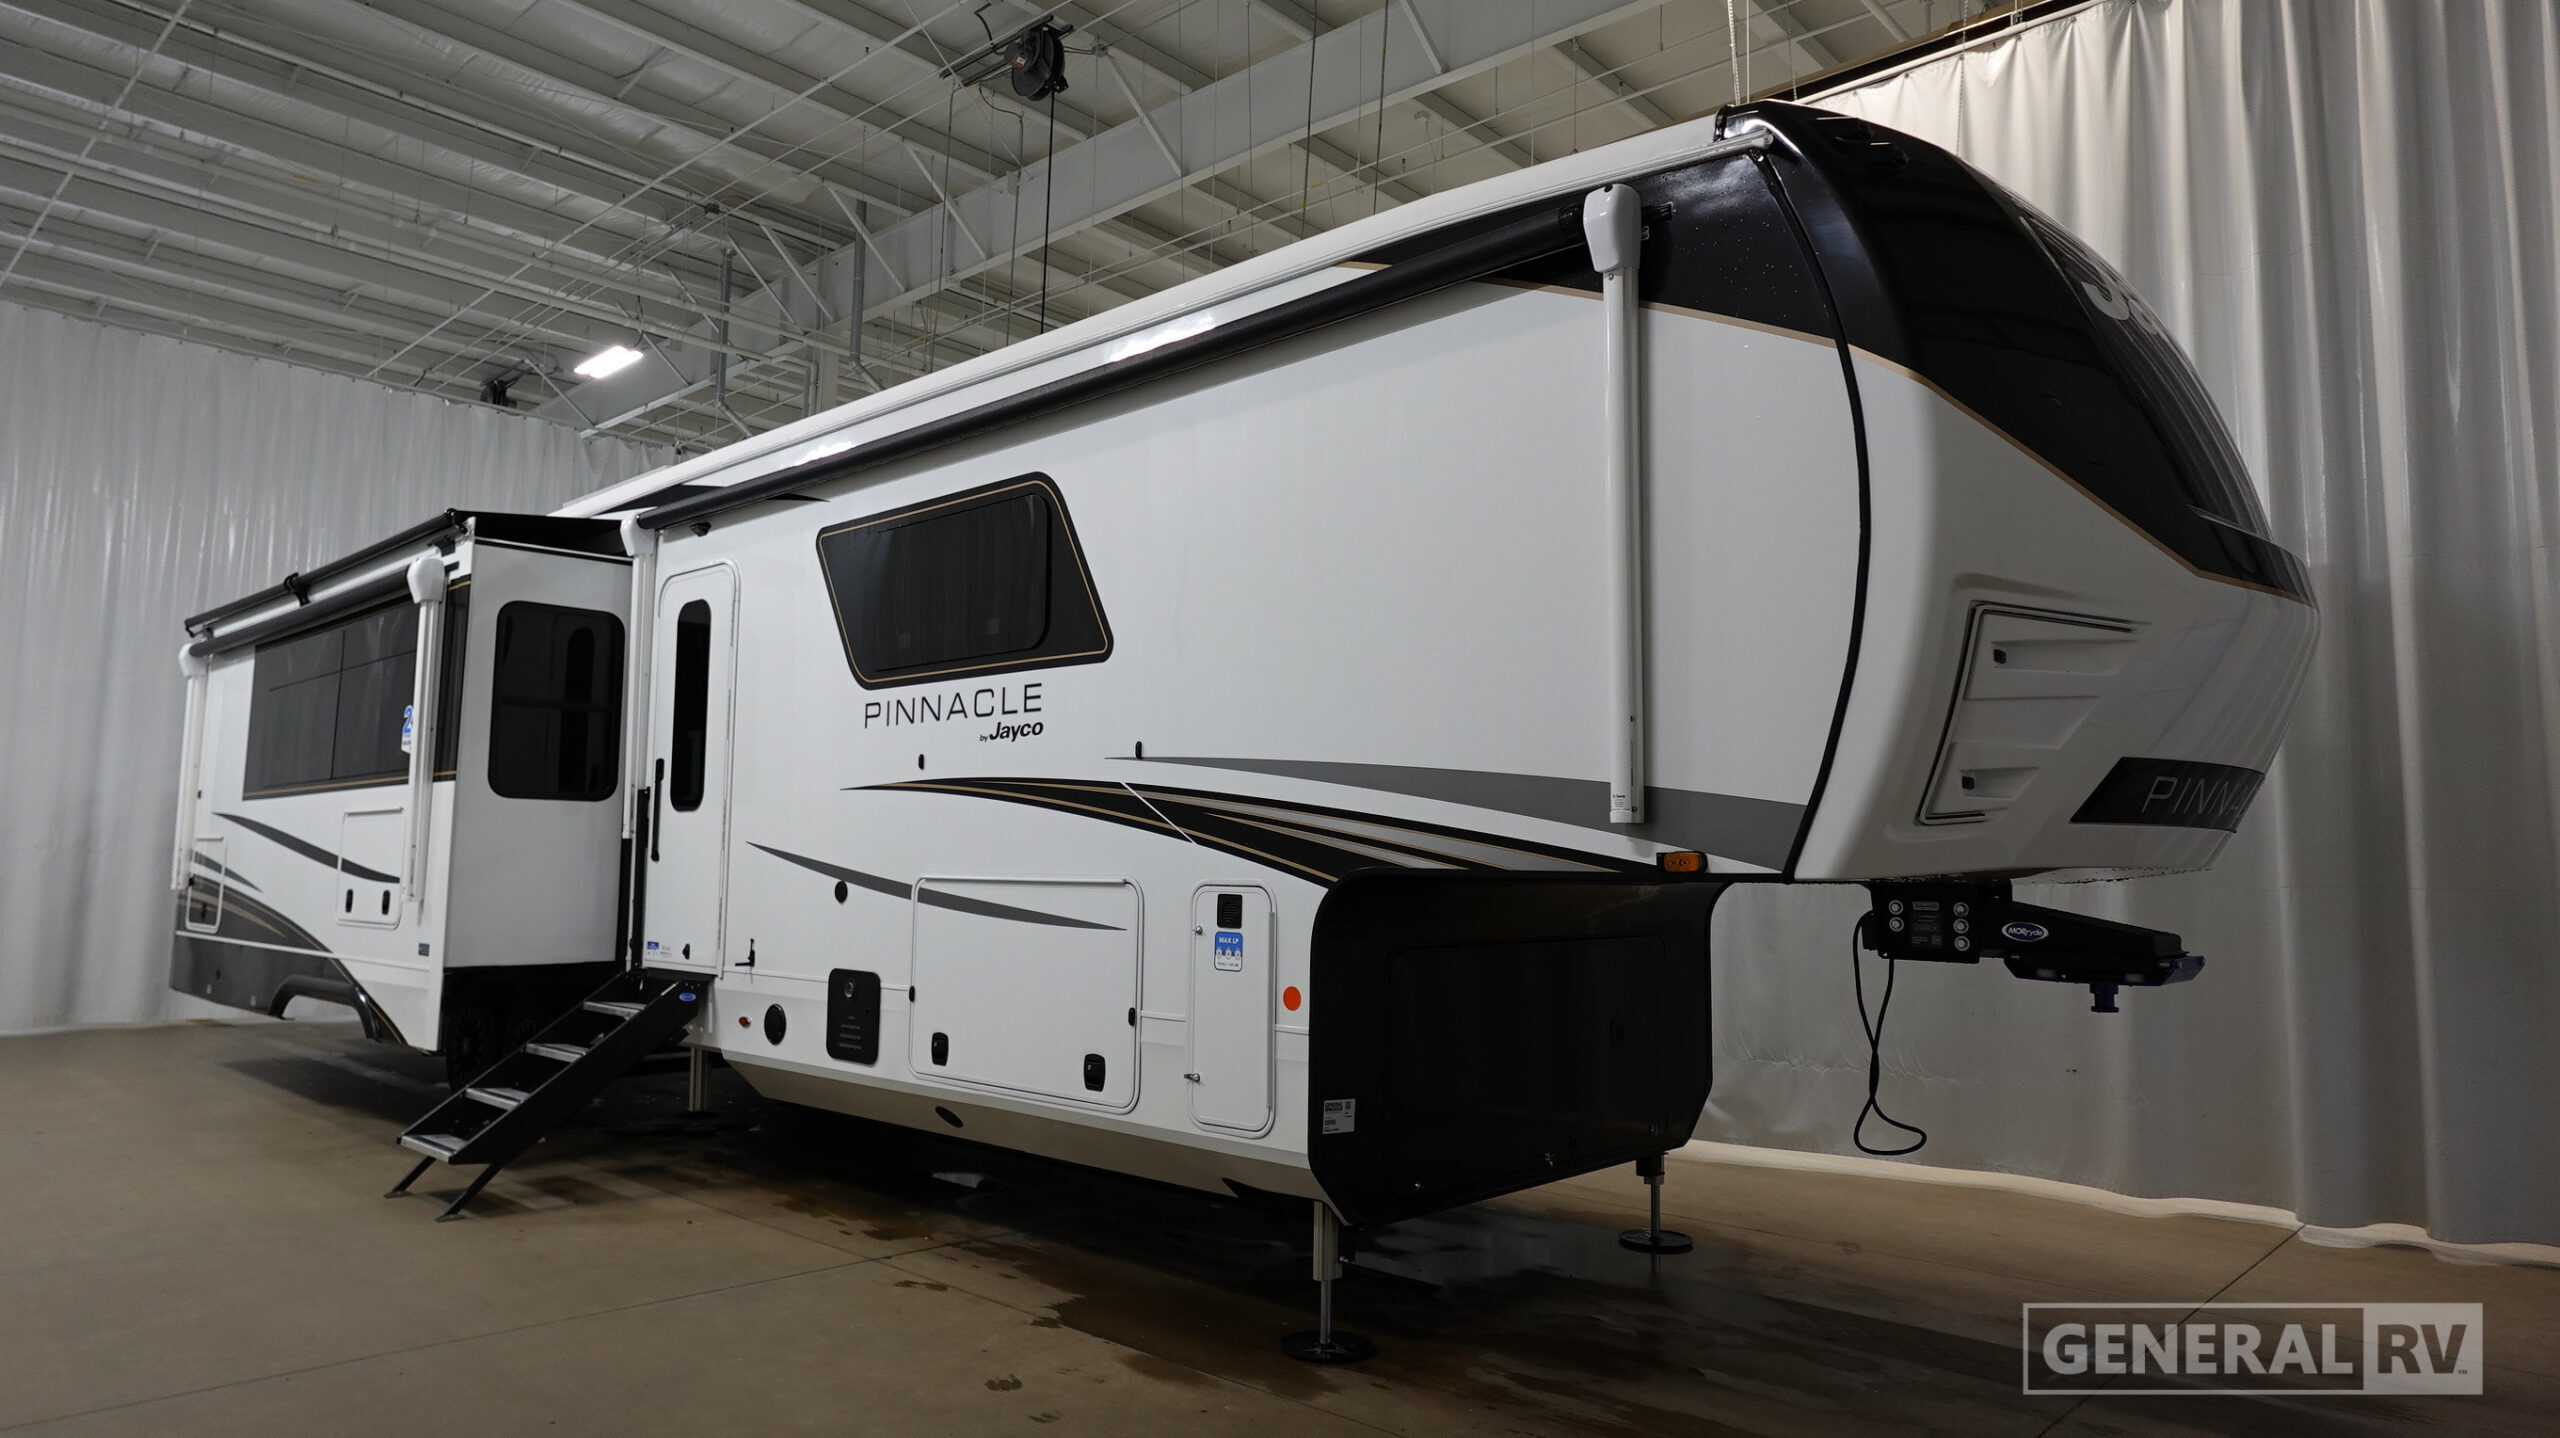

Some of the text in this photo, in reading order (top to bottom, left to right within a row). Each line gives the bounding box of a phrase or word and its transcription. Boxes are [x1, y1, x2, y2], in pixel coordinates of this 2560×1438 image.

[864, 683, 1042, 728] PINNACLE
[979, 721, 1044, 743] by Jayco
[2140, 775, 2249, 817] PINNA
